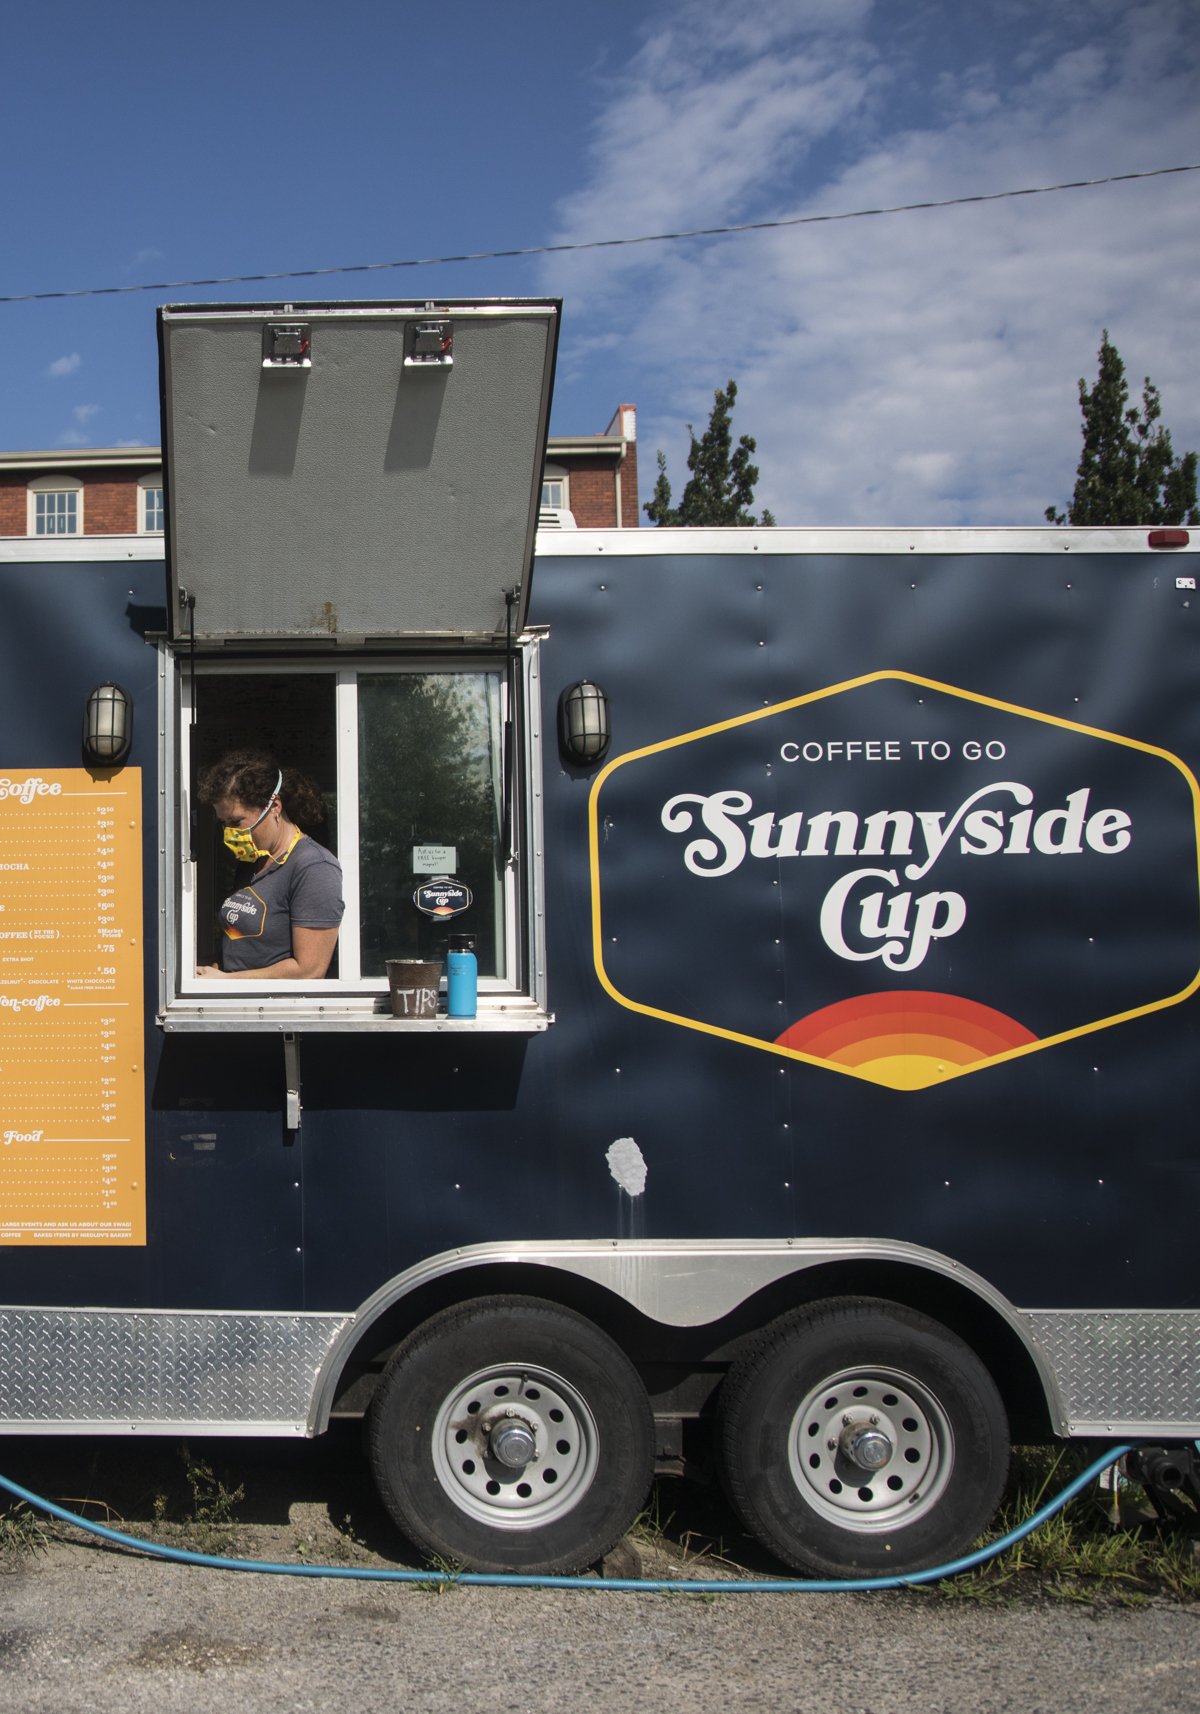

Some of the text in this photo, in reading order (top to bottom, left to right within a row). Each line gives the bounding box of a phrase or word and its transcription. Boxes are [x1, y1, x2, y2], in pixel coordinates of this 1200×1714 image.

[780, 740, 1007, 762] COFFEE TO GO
[661, 781, 1132, 881] Sunnyside
[819, 868, 967, 972] Cup
[4, 1130, 44, 1145] Food
